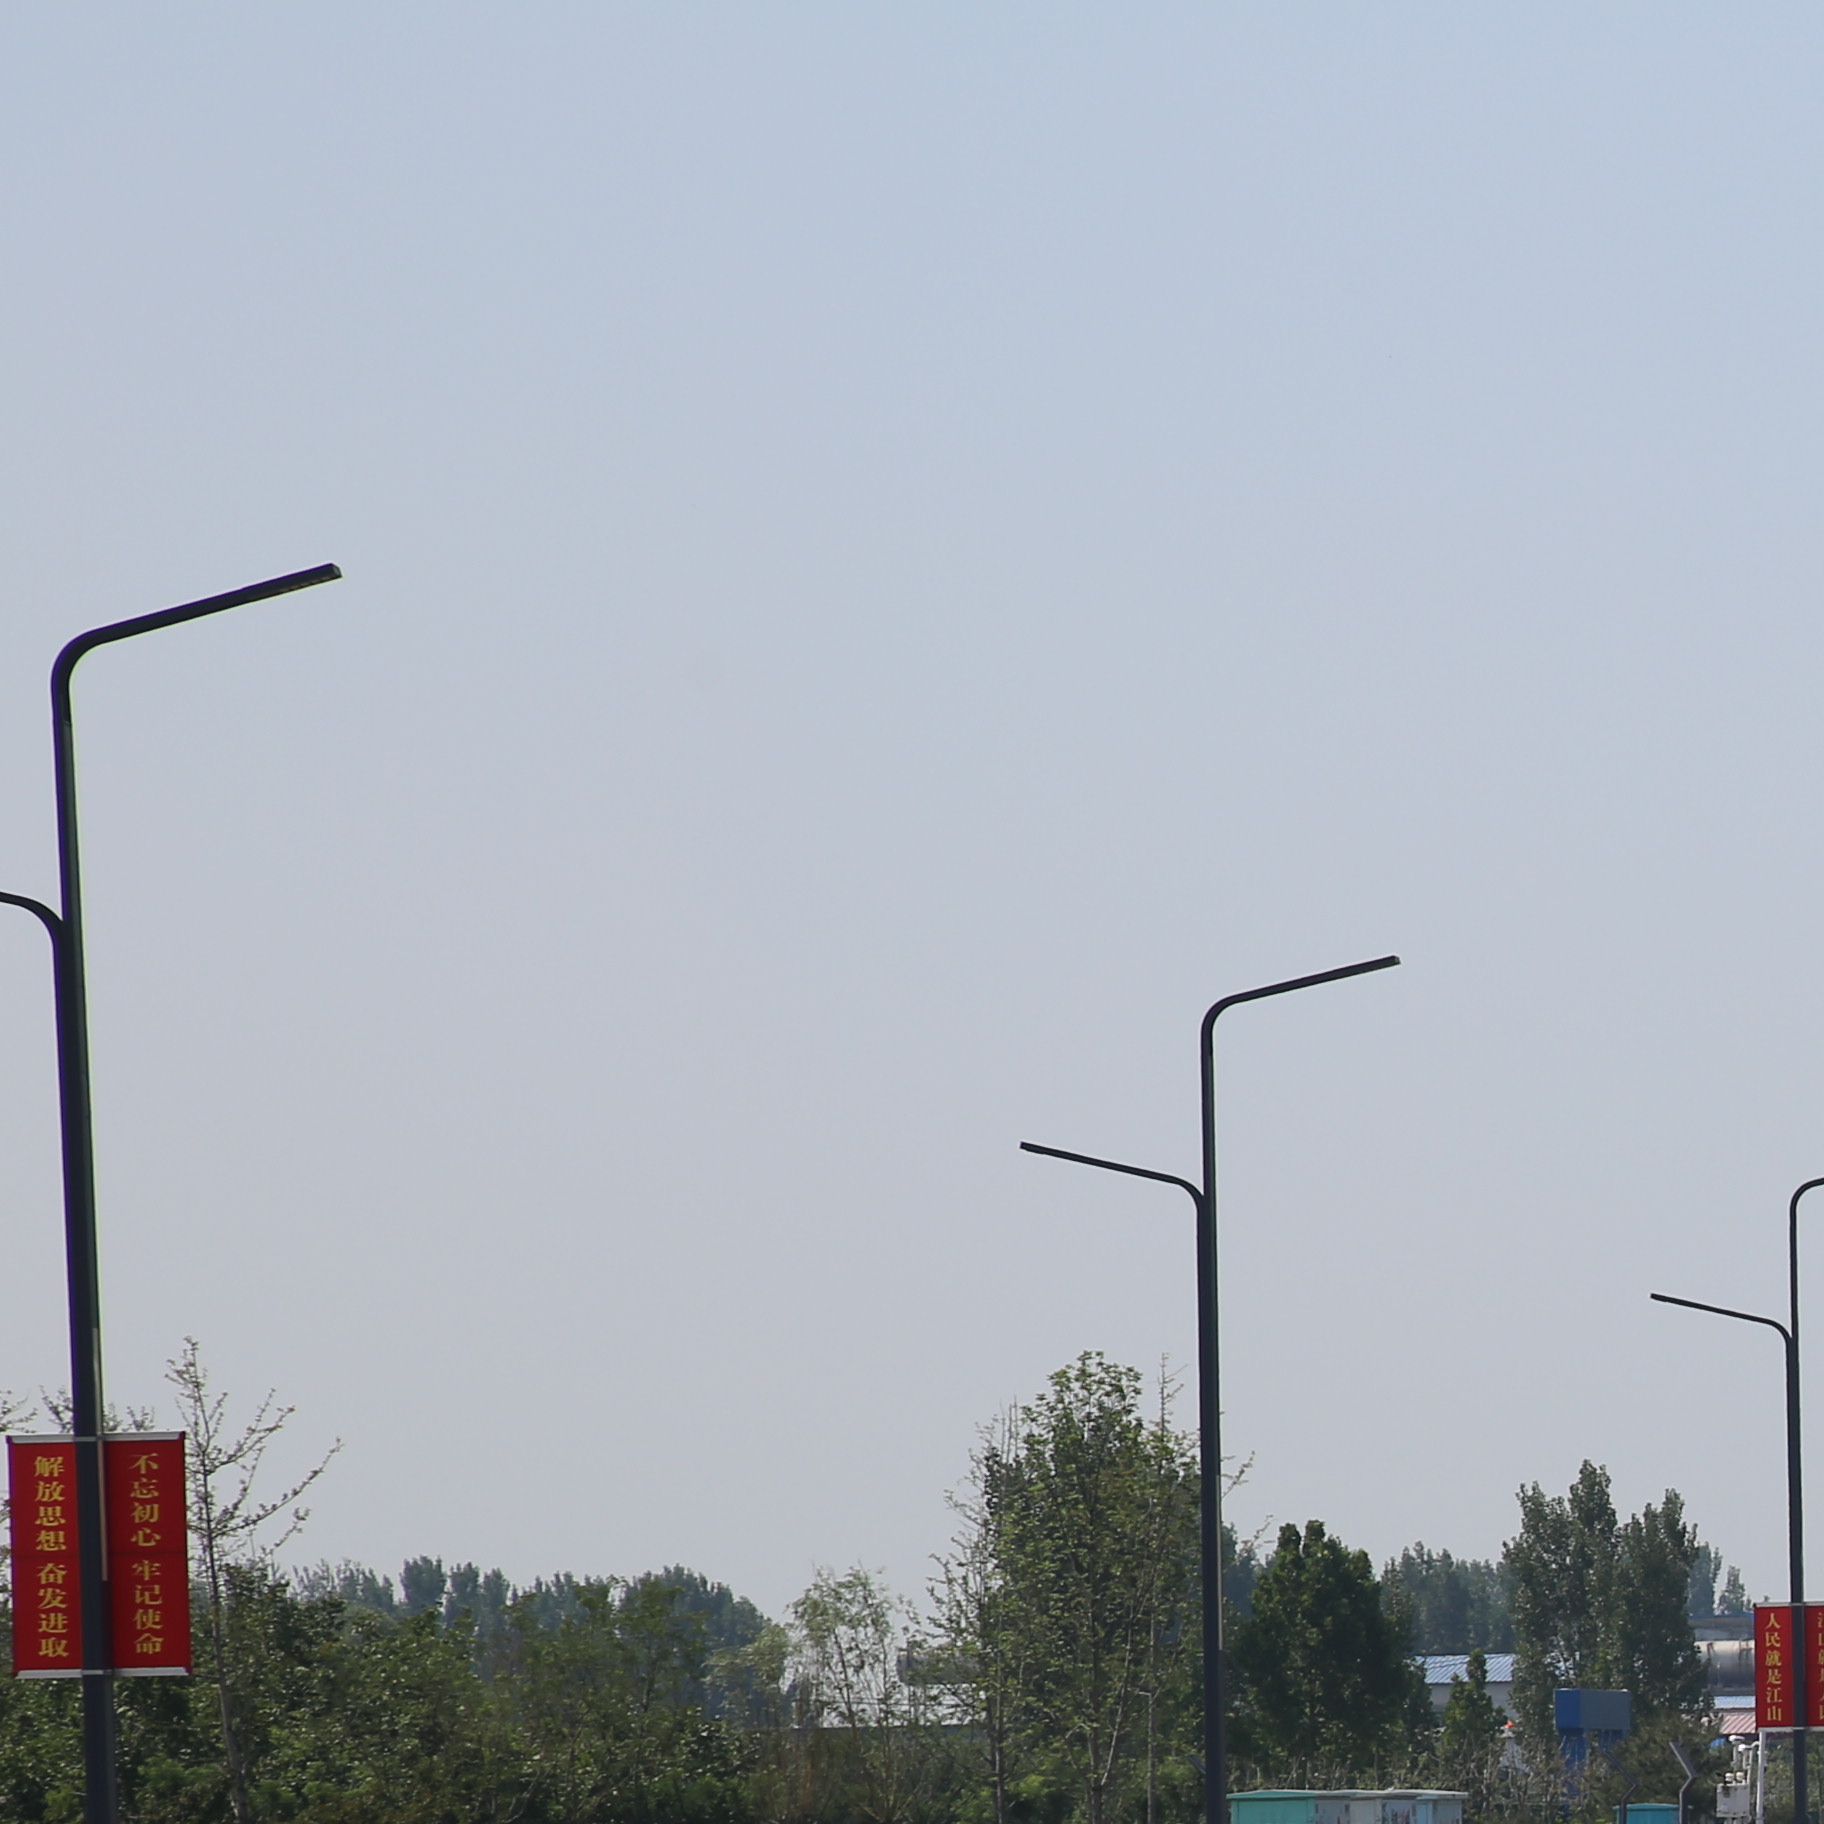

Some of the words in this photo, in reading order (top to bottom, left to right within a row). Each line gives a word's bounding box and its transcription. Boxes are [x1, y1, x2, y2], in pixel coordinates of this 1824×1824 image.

[34, 1456, 66, 1551] 解放思想
[129, 1453, 161, 1547] 不忘初心
[37, 1563, 69, 1658] 奋发进取
[132, 1560, 164, 1655] 牢记使命
[1765, 1612, 1782, 1721] 人民就是江山
